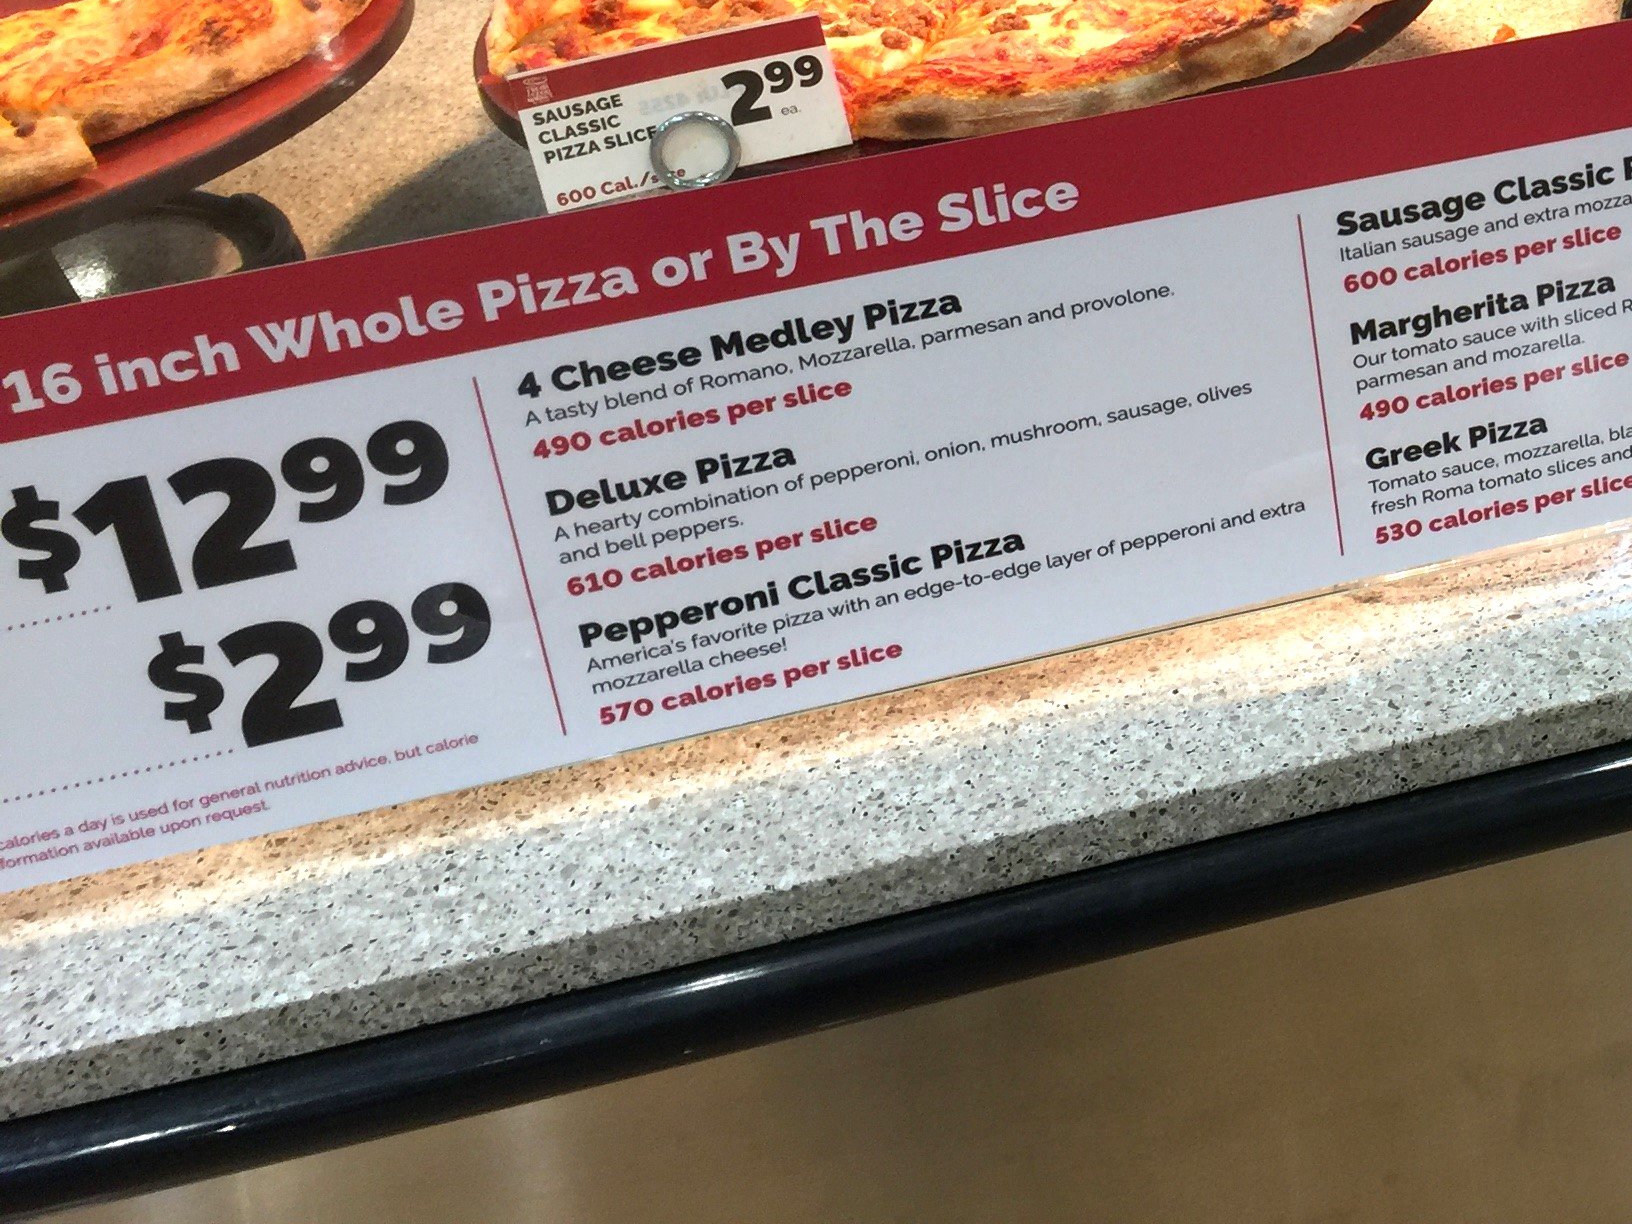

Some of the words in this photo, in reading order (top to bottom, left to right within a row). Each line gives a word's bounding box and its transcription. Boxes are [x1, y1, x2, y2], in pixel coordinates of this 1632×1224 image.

[532, 93, 623, 126] SAUSAGE
[720, 54, 824, 127] 299
[538, 115, 622, 145] CLASSIC
[543, 140, 602, 165] PIZZA
[556, 186, 597, 207] 600
[1336, 191, 1487, 237] Sausage
[1493, 162, 1616, 206] Classic
[1339, 240, 1397, 262] Italian
[1401, 224, 1480, 250] sausage
[1484, 212, 1519, 234] and
[1523, 206, 1570, 226] extra
[1343, 266, 1398, 294] 600
[1403, 248, 1509, 282] calories
[1513, 237, 1558, 265] per
[1561, 225, 1622, 250] slice
[2, 363, 82, 413] 16
[94, 335, 240, 395] inch
[246, 296, 464, 363] Whole
[478, 267, 638, 322] Pizza
[651, 249, 712, 287] or
[726, 231, 800, 277] By
[810, 210, 923, 255] The
[938, 182, 1078, 232] Slice
[1349, 292, 1530, 346] Margherita
[1535, 275, 1616, 307] Pizza
[516, 371, 543, 399] 4
[550, 346, 703, 392] Cheese
[709, 313, 855, 362] Medley
[862, 294, 963, 331] Pizza
[544, 400, 599, 423] tasty
[603, 382, 668, 411] blend
[699, 362, 794, 391] Romano,
[798, 336, 916, 371] Mozzarella,
[920, 315, 1023, 350] parmesan
[1027, 302, 1066, 325] and
[1070, 285, 1175, 320] provolone.
[1352, 351, 1387, 369] Our
[1391, 337, 1458, 362] tomato
[1462, 325, 1517, 347] sauce
[1520, 314, 1559, 334] with
[1564, 301, 1617, 326] sliced
[1356, 361, 1448, 395] parmesan
[1453, 349, 1488, 371] and
[532, 431, 592, 459] 490
[598, 408, 721, 446] calories
[726, 395, 777, 426] per
[782, 381, 853, 409] slice
[1365, 431, 1463, 470] Greek
[1468, 417, 1549, 449] Pizza
[544, 470, 688, 517] Deluxe
[694, 447, 797, 485] Pizza
[573, 511, 642, 538] hearty
[647, 483, 779, 522] combination
[809, 450, 920, 491] pepperoni,
[924, 440, 986, 462] onion,
[990, 415, 1102, 448] mushroom,
[1106, 396, 1193, 424] sausage,
[1196, 382, 1253, 405] olives
[1367, 470, 1437, 494] Tomato
[1441, 457, 1499, 479] sauce,
[1503, 433, 1604, 465] mozzarella,
[1370, 493, 1417, 515] fresh
[1421, 483, 1475, 504] Roma
[1478, 467, 1543, 492] tomato
[1547, 456, 1597, 477] slices
[559, 541, 601, 565] and
[604, 531, 648, 555] bell
[651, 515, 744, 549] peppers.
[1375, 519, 1423, 545] 530
[1428, 498, 1529, 532] calories
[1534, 487, 1576, 514] per
[577, 580, 780, 649] Pepperoni
[787, 554, 924, 601] Classic
[929, 533, 1026, 570] Pizza
[586, 639, 687, 674] America's
[690, 622, 768, 649] favorite
[772, 609, 824, 635] pizza
[826, 597, 871, 618] with
[903, 560, 1042, 601] edge-to-edge
[1045, 548, 1093, 570] layer
[1120, 517, 1216, 556] pepperoni
[1220, 508, 1256, 530] and
[1259, 501, 1306, 521] extra
[591, 658, 704, 695] mozzarella
[708, 636, 787, 668] cheese!
[660, 672, 777, 711] calories
[783, 659, 831, 689] per
[836, 644, 903, 671] slice
[77, 818, 108, 833] day
[128, 802, 170, 823] used
[172, 798, 195, 812] for
[198, 781, 262, 809] general
[263, 767, 332, 792] nutrition
[393, 745, 423, 762] but
[425, 734, 479, 755] calorie
[83, 826, 156, 852] available
[159, 816, 202, 835] upon
